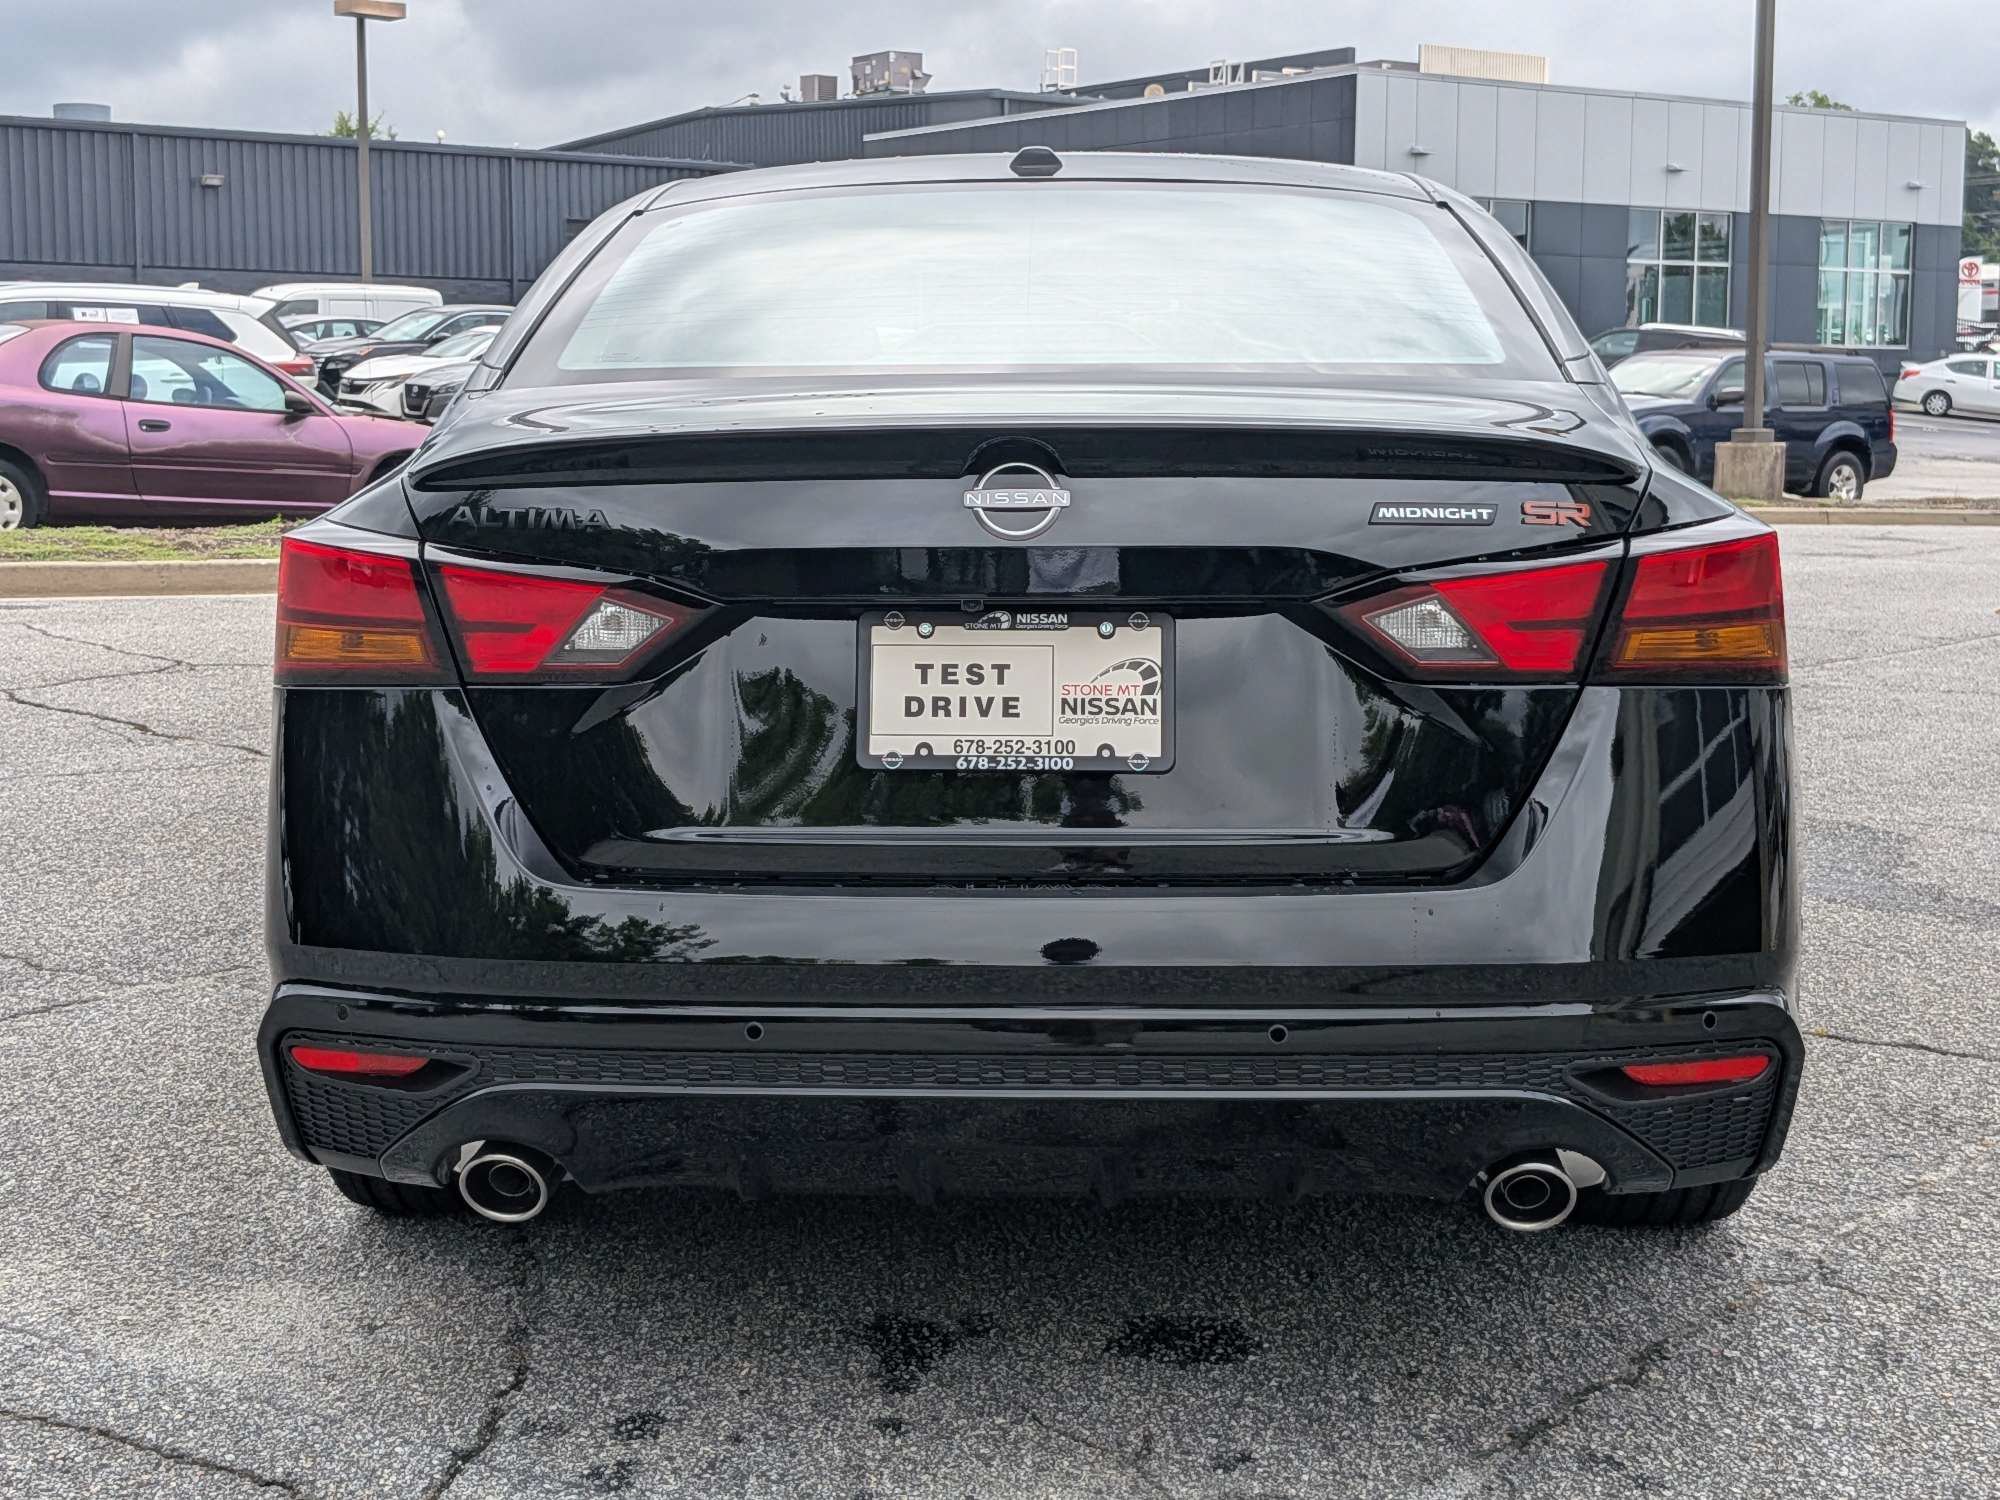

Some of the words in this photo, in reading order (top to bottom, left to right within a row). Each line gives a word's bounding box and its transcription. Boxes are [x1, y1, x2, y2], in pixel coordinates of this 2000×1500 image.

[966, 492, 1067, 505] NISSAN
[450, 505, 612, 529] ALTIMA
[1378, 506, 1495, 521] MIDNIGHT
[1520, 500, 1592, 527] SR
[1016, 613, 1068, 624] NISSAN
[915, 663, 1011, 685] TEST
[1061, 684, 1113, 696] STONE
[1116, 684, 1140, 696] MT
[904, 696, 1021, 718] DRIVE
[1060, 697, 1158, 716] NISSAN
[1058, 716, 1100, 727] Georgia's
[1101, 716, 1132, 727] Driving
[1133, 717, 1160, 725] Force
[953, 739, 1076, 755] 678-252-3100
[956, 756, 1074, 770] 678-252-3100
